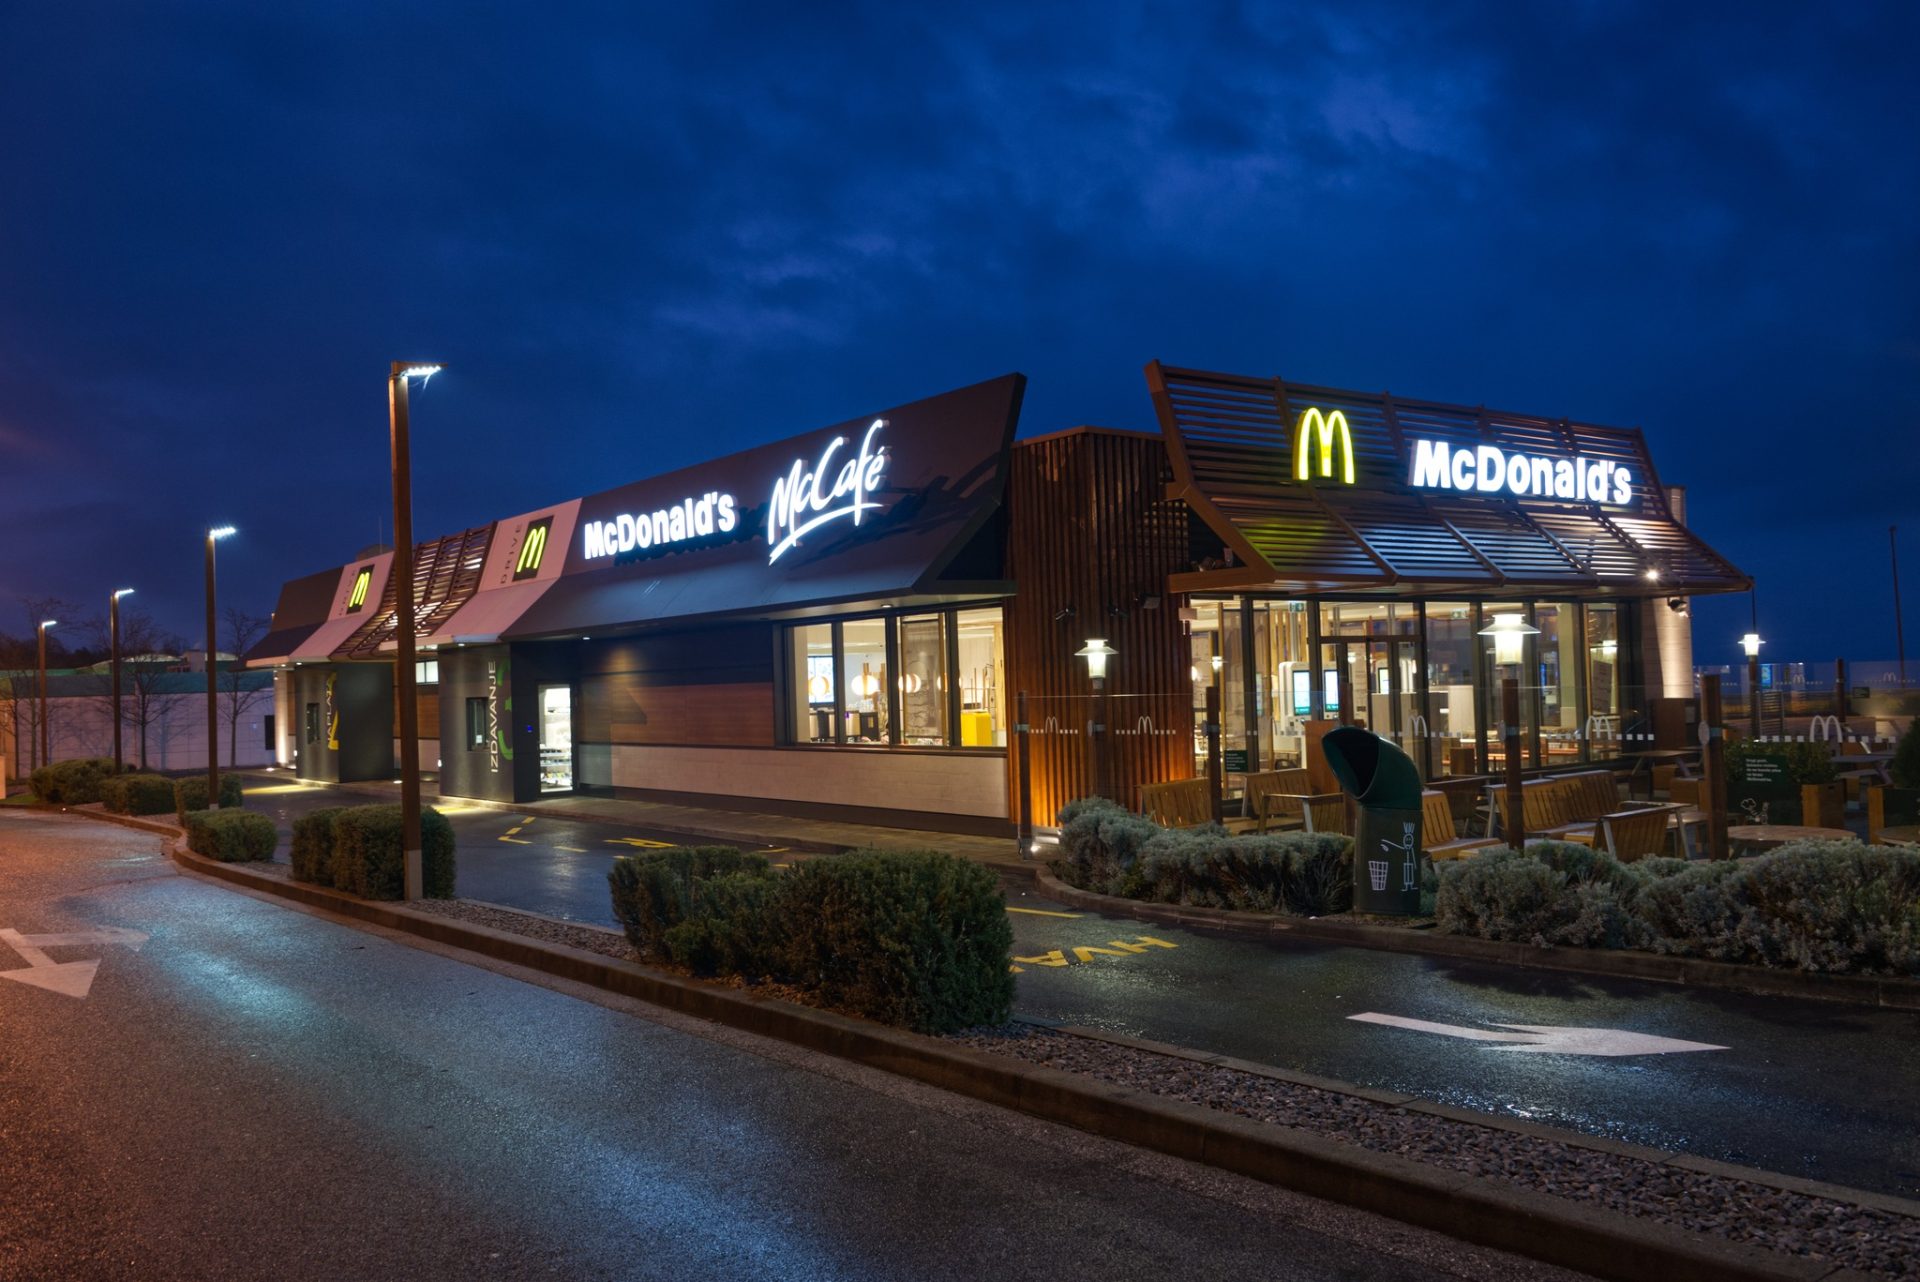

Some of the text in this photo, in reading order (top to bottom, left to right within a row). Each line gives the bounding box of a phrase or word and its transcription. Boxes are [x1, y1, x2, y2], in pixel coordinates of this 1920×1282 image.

[768, 419, 885, 548] McCafé
[1412, 439, 1632, 504] McDonald's
[501, 523, 523, 584] DRIVE
[584, 491, 735, 560] McDonald's
[488, 661, 498, 772] IZDAVANJE
